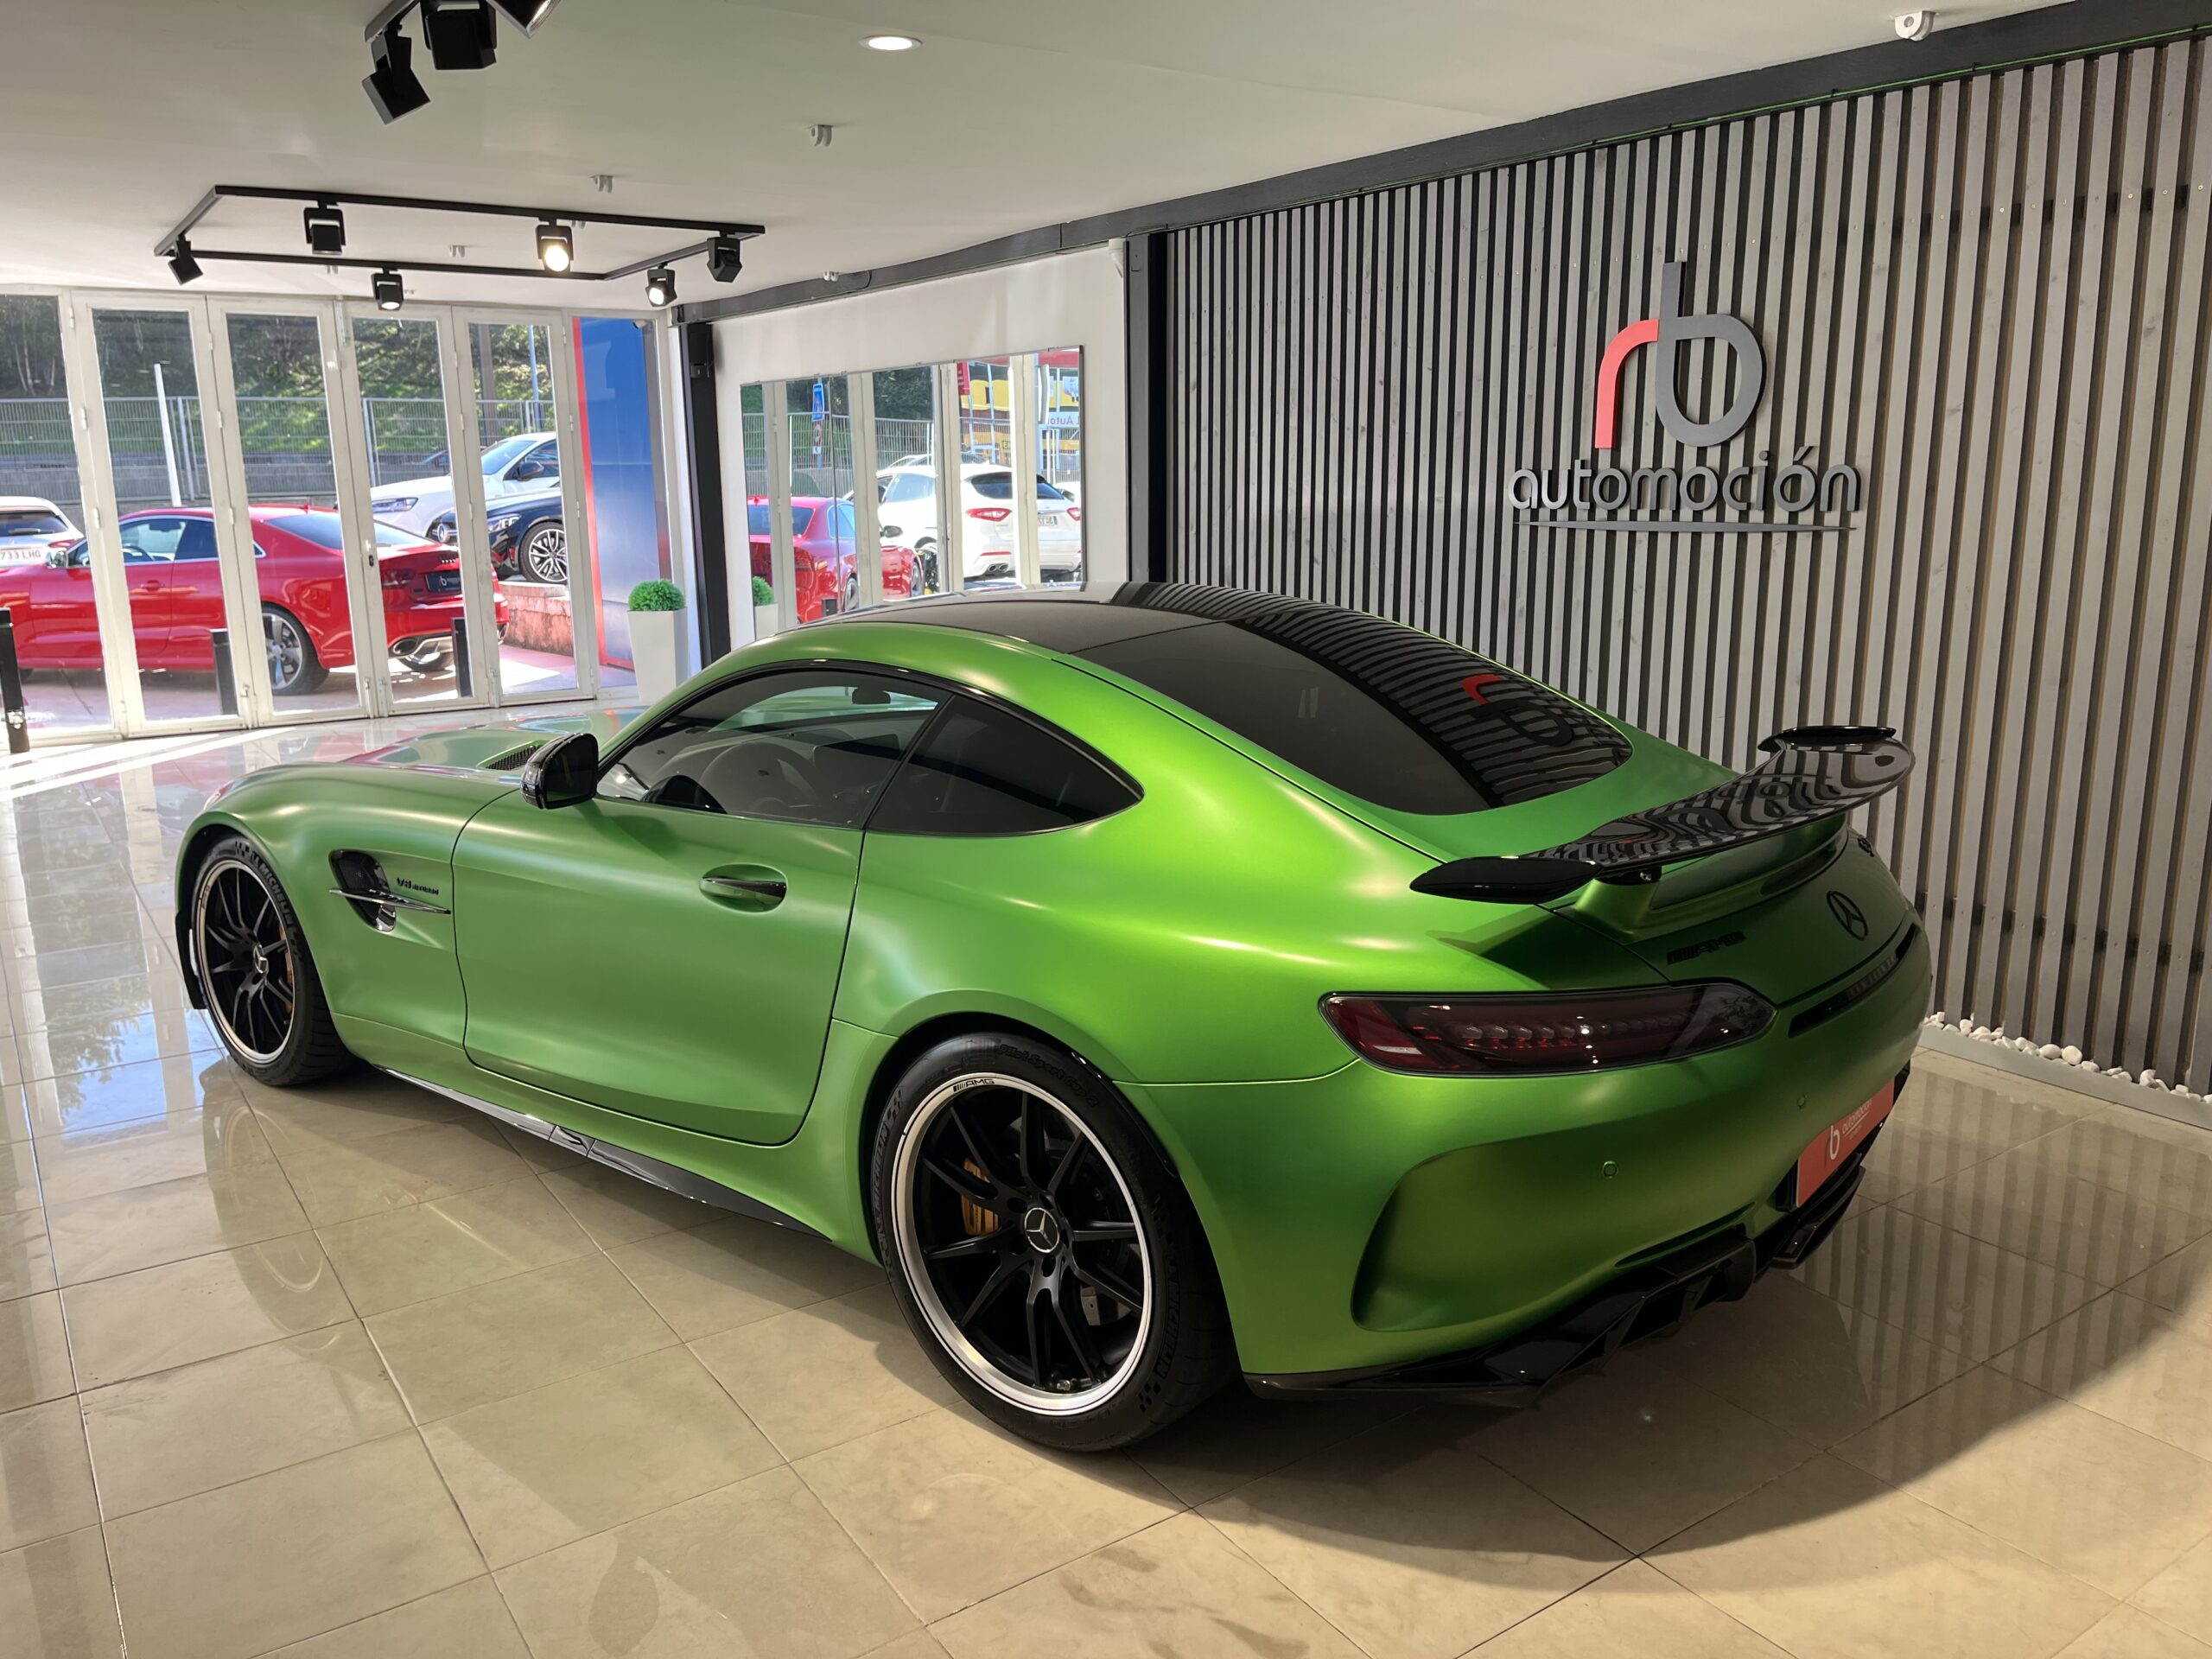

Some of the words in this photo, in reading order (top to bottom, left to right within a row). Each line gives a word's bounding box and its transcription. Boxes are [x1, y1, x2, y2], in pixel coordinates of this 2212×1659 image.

[1595, 262, 1766, 448] rb
[1508, 446, 1861, 512] automoción
[261, 862, 295, 926] MICHELIN
[997, 1044, 1029, 1061] Pilot
[1028, 1054, 1065, 1079] Sport
